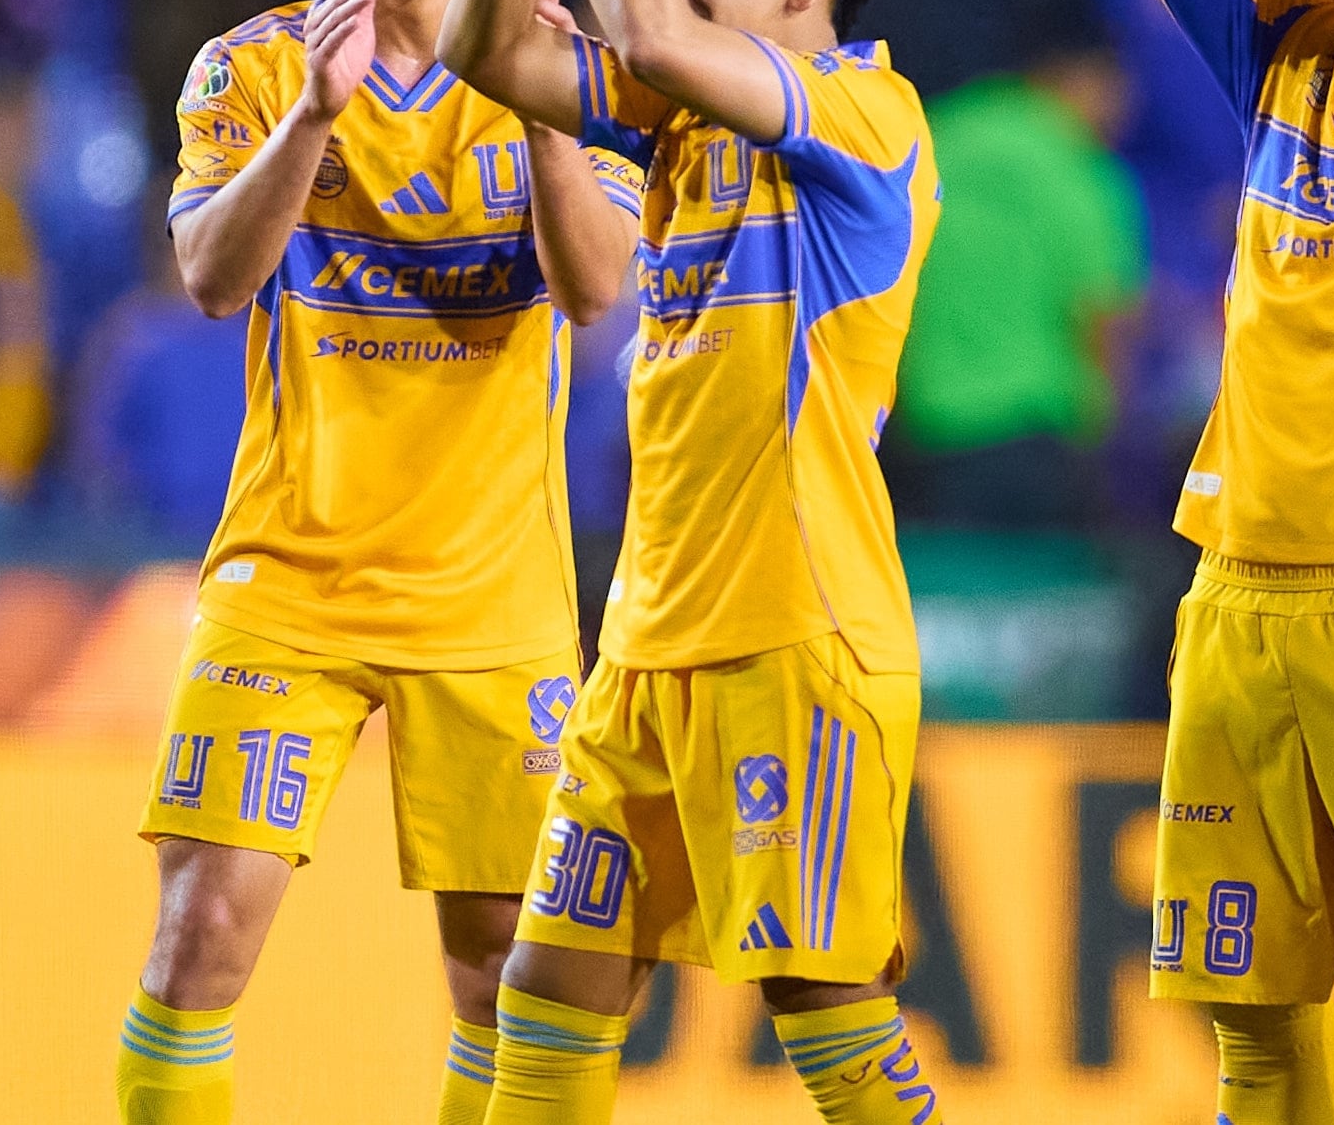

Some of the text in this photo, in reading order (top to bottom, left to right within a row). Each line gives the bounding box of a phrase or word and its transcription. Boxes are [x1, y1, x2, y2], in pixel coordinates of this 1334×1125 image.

[360, 264, 515, 298] CEMEX
[311, 331, 506, 362] SPORTIUMBET
[207, 665, 292, 696] CEMEX
[238, 729, 312, 830] 16
[1164, 802, 1235, 823] CEMEX
[529, 816, 629, 929] 30
[1205, 880, 1257, 976] 8
